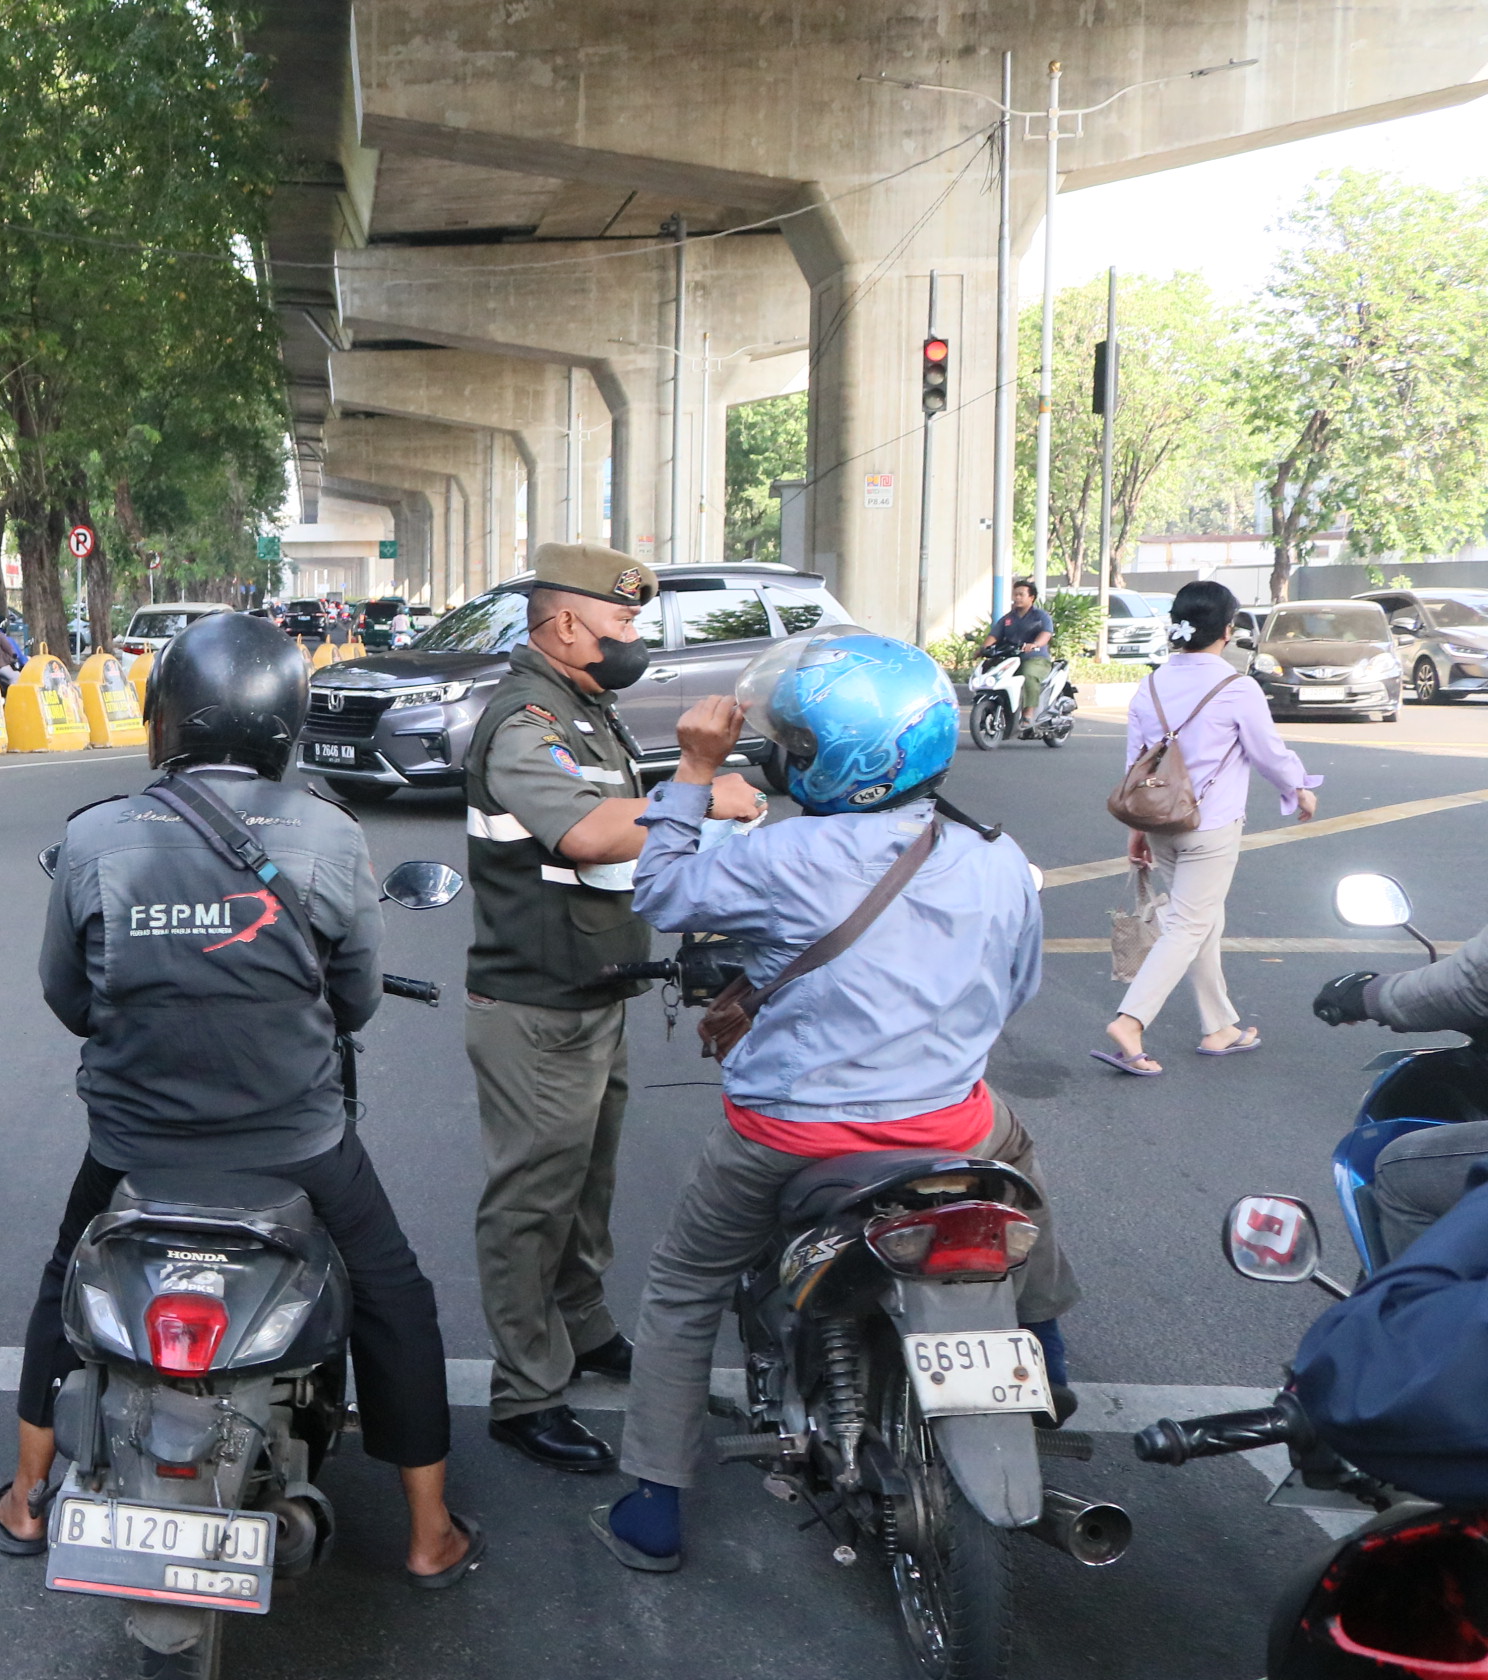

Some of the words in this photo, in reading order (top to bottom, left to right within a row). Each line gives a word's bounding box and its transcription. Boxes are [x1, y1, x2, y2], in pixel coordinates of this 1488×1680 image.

[315, 743, 320, 756] B
[130, 902, 231, 929] FSPMI
[166, 1249, 229, 1262] HONDA
[187, 1283, 215, 1294] PKS
[915, 1339, 990, 1373] 6691
[68, 1508, 86, 1542] B
